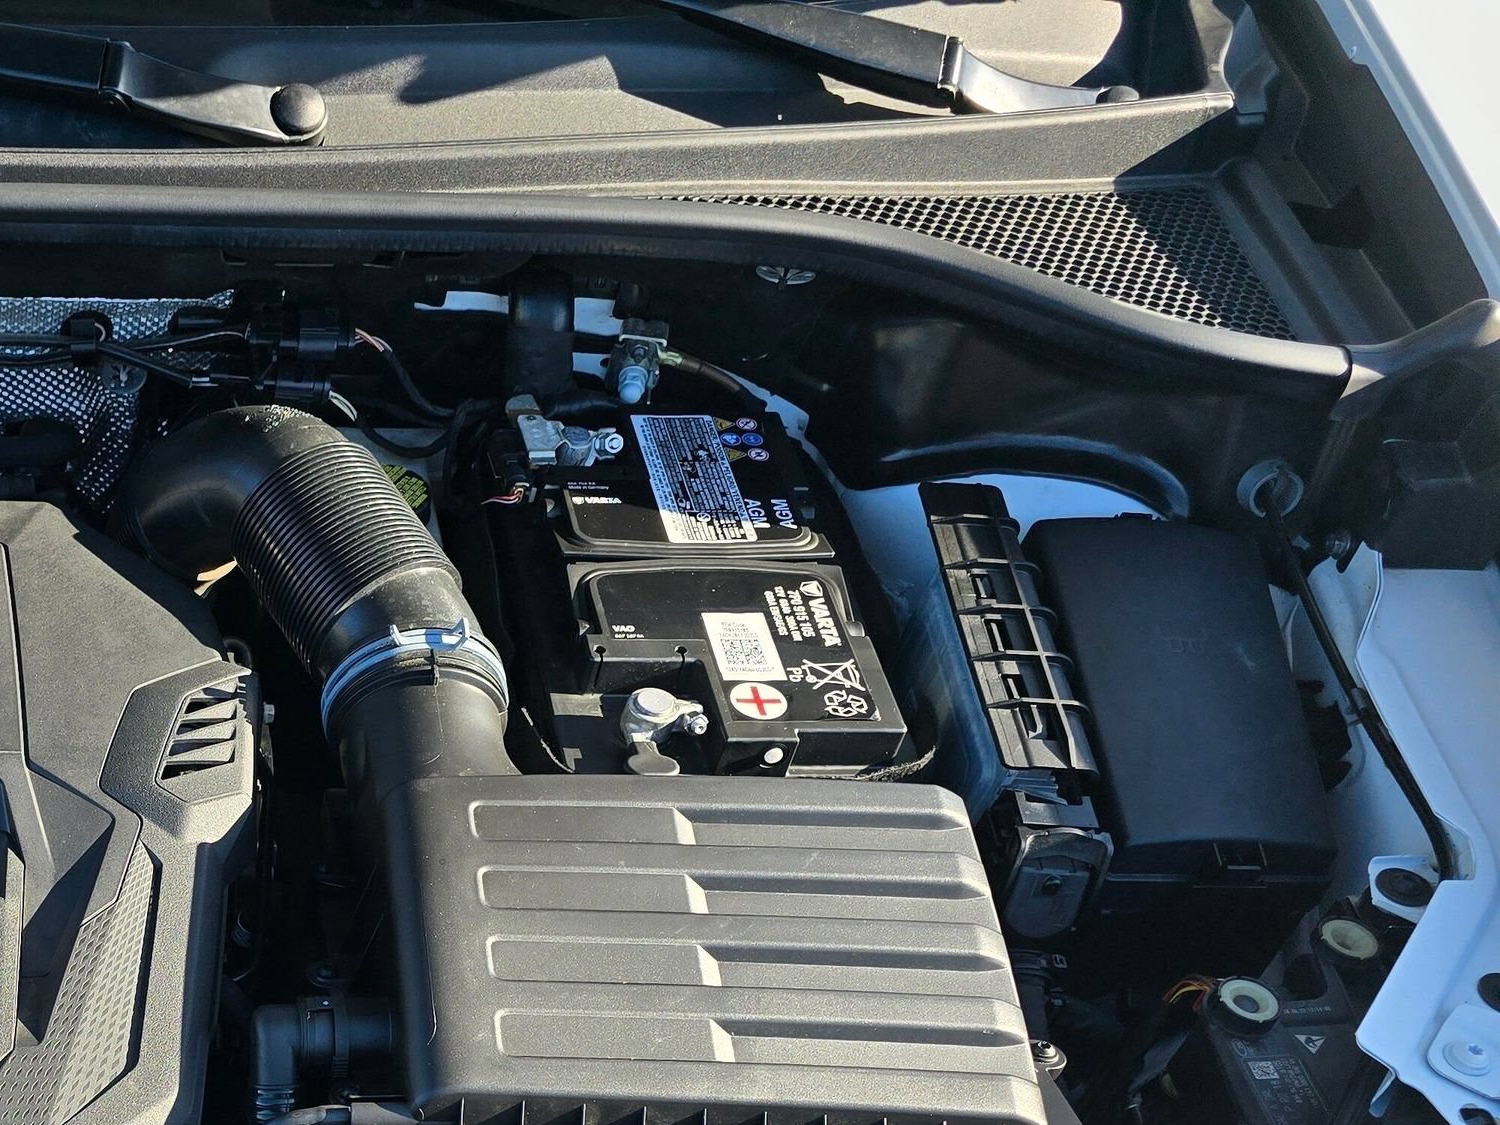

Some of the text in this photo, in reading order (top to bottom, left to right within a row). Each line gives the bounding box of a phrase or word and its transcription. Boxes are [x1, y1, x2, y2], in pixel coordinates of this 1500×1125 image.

[744, 499, 770, 528] AGM
[771, 499, 798, 529] AGM
[787, 590, 815, 637] 7P0 915 105
[808, 597, 842, 647] VARTA
[786, 667, 804, 682] Pb
